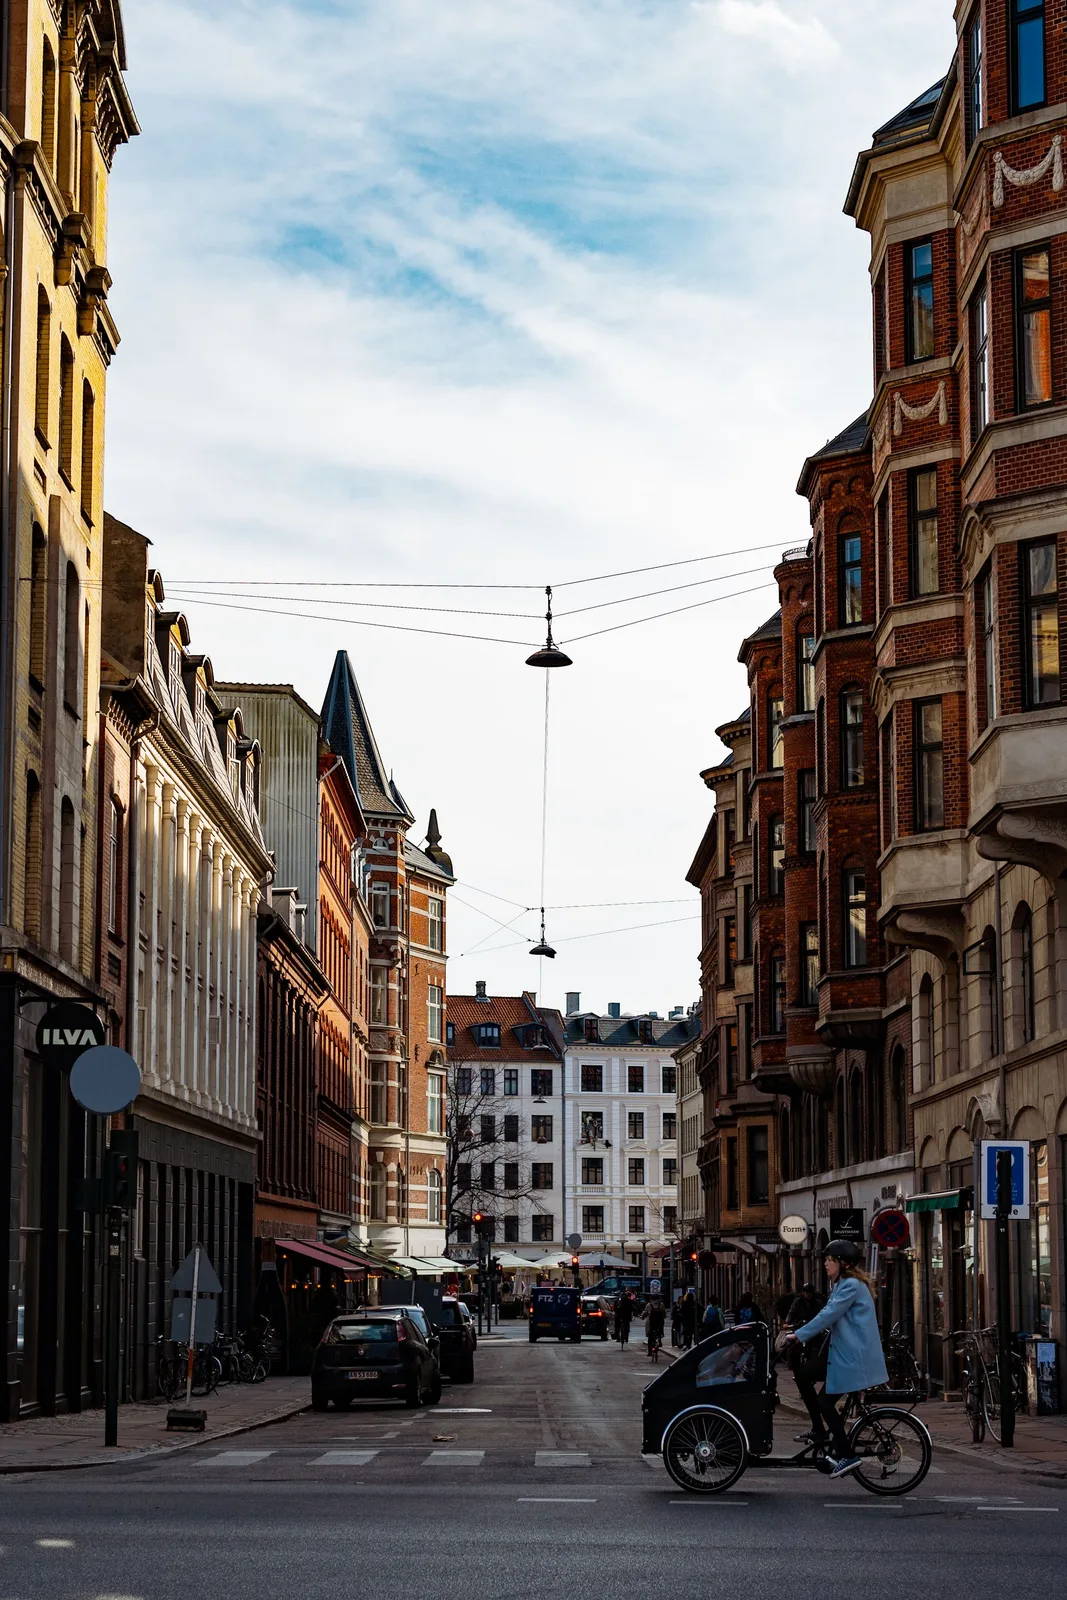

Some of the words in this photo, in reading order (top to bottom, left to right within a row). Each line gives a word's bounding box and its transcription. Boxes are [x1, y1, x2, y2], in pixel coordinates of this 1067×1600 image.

[42, 1028, 98, 1045] ILVA
[992, 1207, 1019, 1215] Ze
[782, 1225, 807, 1233] Form+
